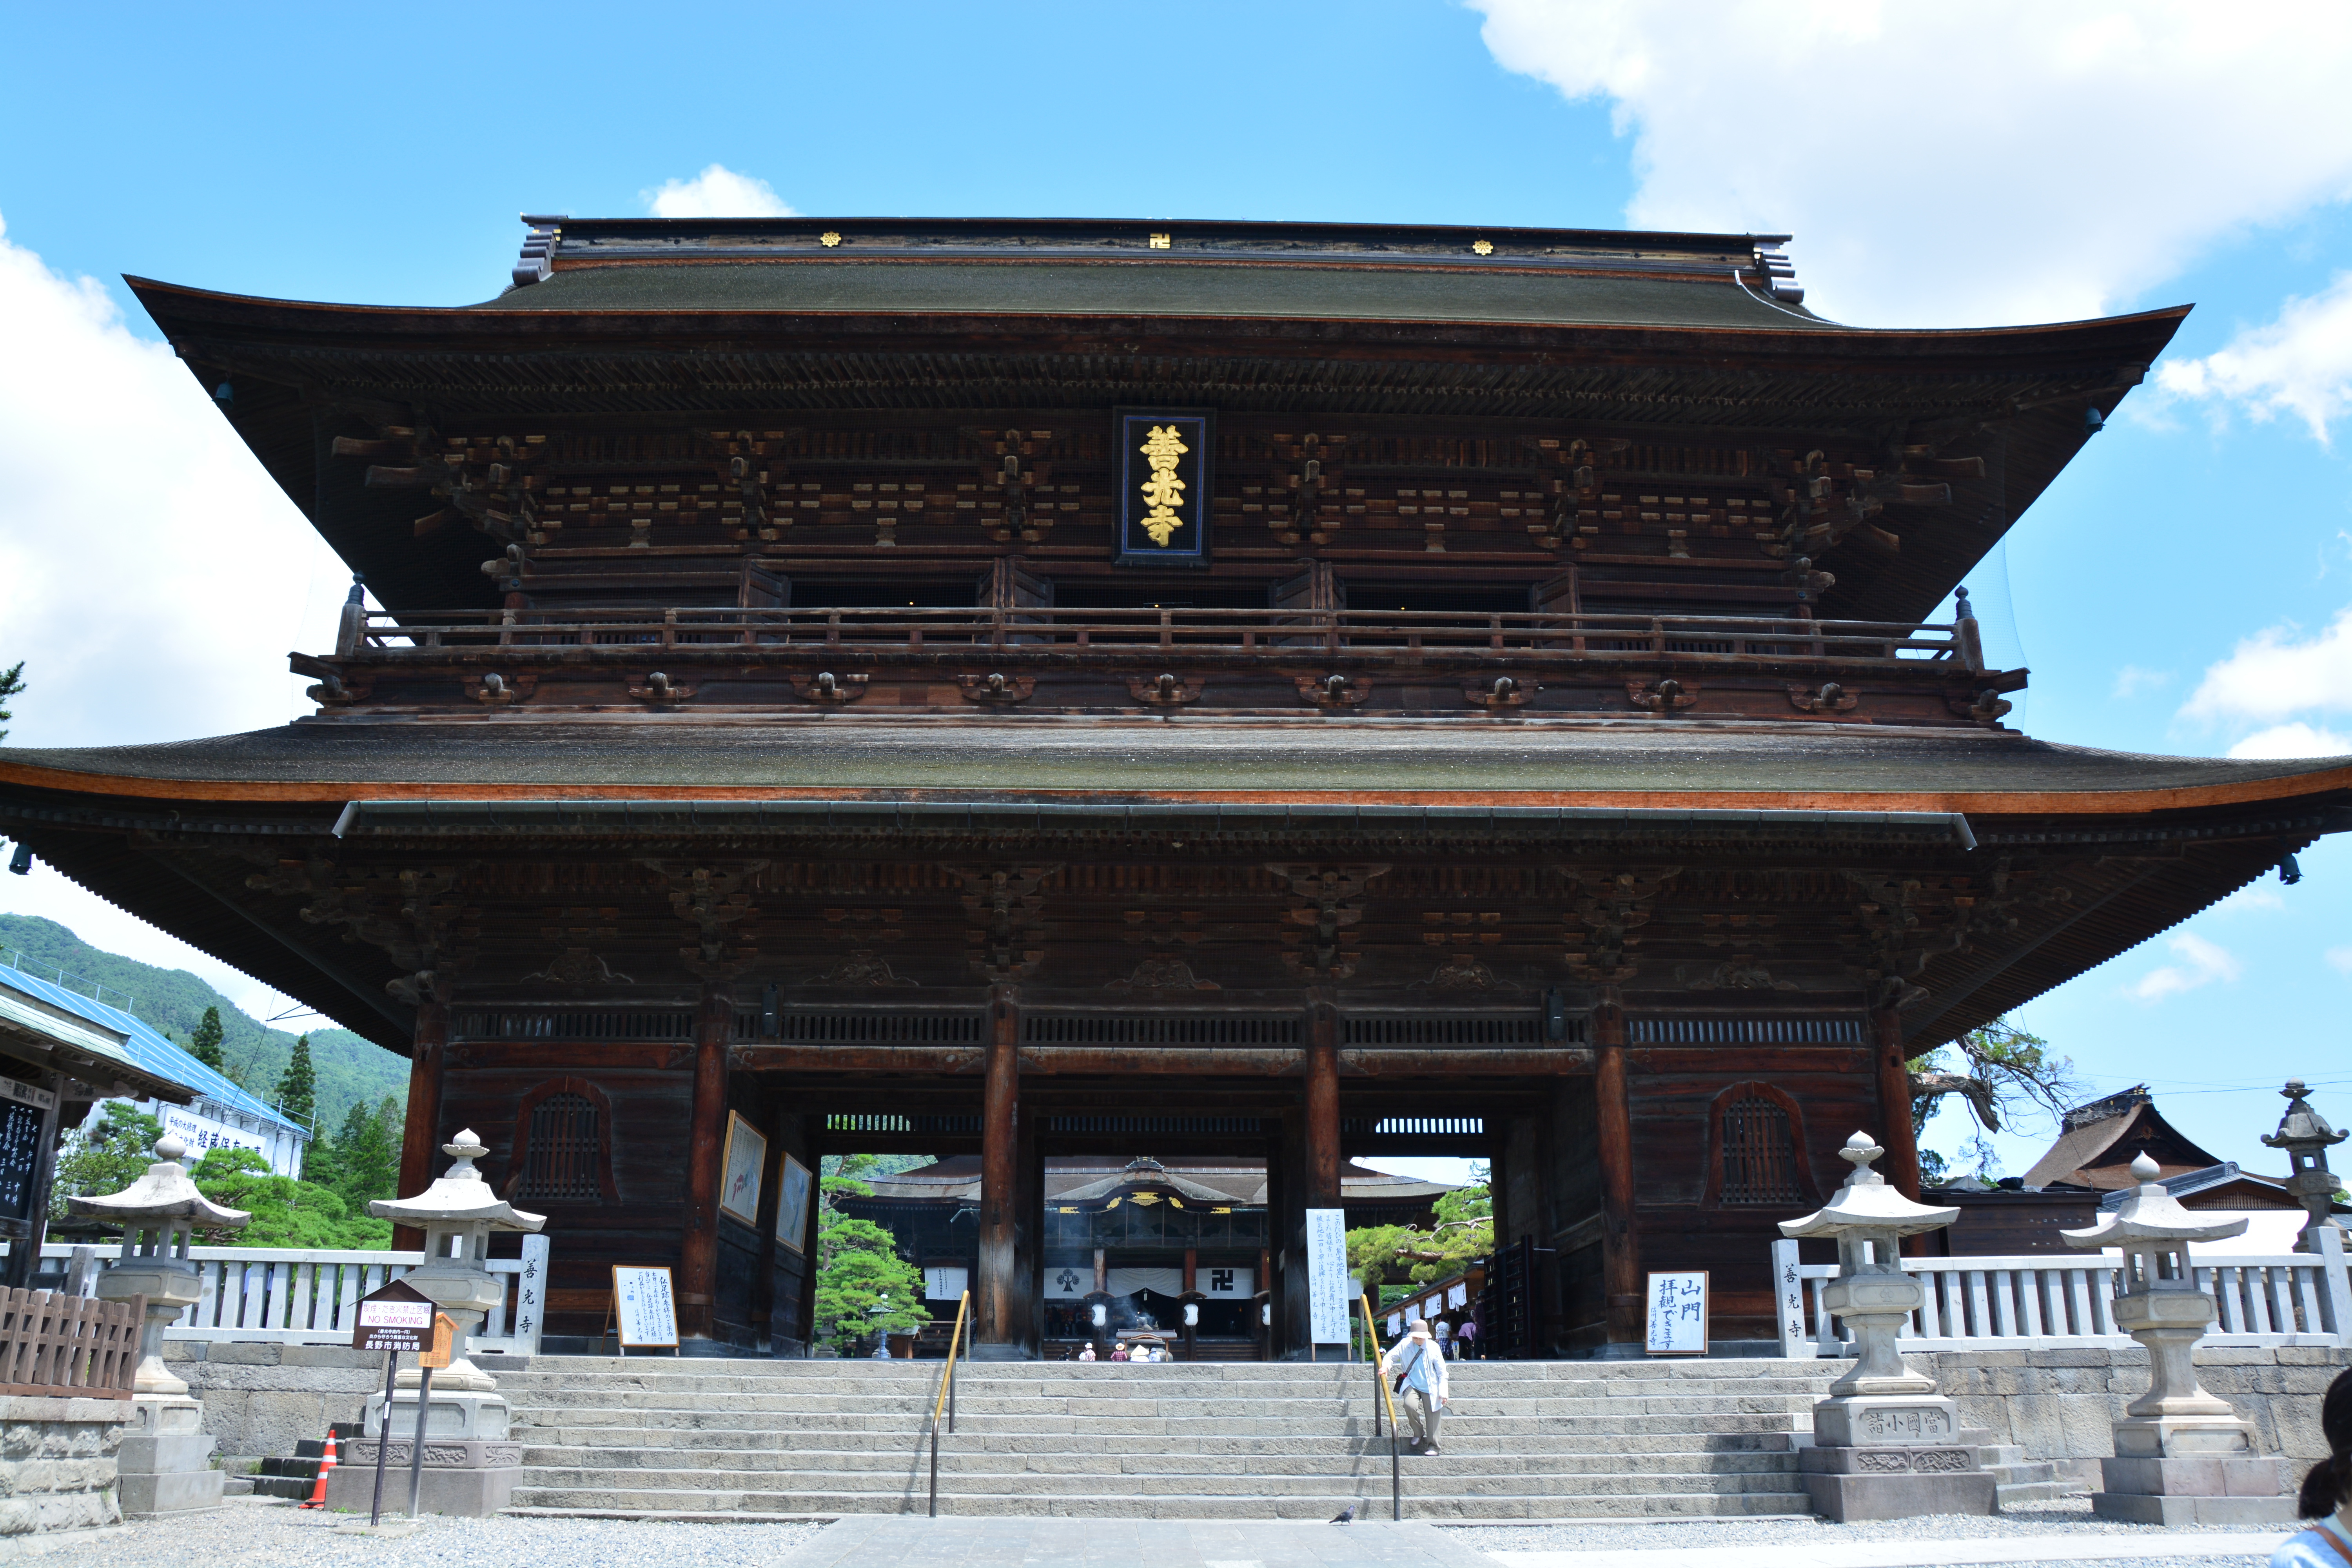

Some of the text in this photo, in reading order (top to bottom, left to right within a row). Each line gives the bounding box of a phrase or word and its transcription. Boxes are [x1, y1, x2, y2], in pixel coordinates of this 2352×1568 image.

[1140, 425, 1189, 547] 善光寺
[169, 1116, 197, 1133] 平成の大修理
[363, 1304, 430, 1315] 喫煙・たき火禁止区域
[383, 1316, 423, 1325] SMOKING
[520, 1259, 537, 1333] 善光寺
[659, 1276, 673, 1337] 仏足跡参拝のご案内
[1658, 1279, 1678, 1350] 拝観できます
[1681, 1279, 1701, 1321] 山門
[1784, 1263, 1802, 1337] 善光寺
[365, 1340, 420, 1351] 長野市消防局
